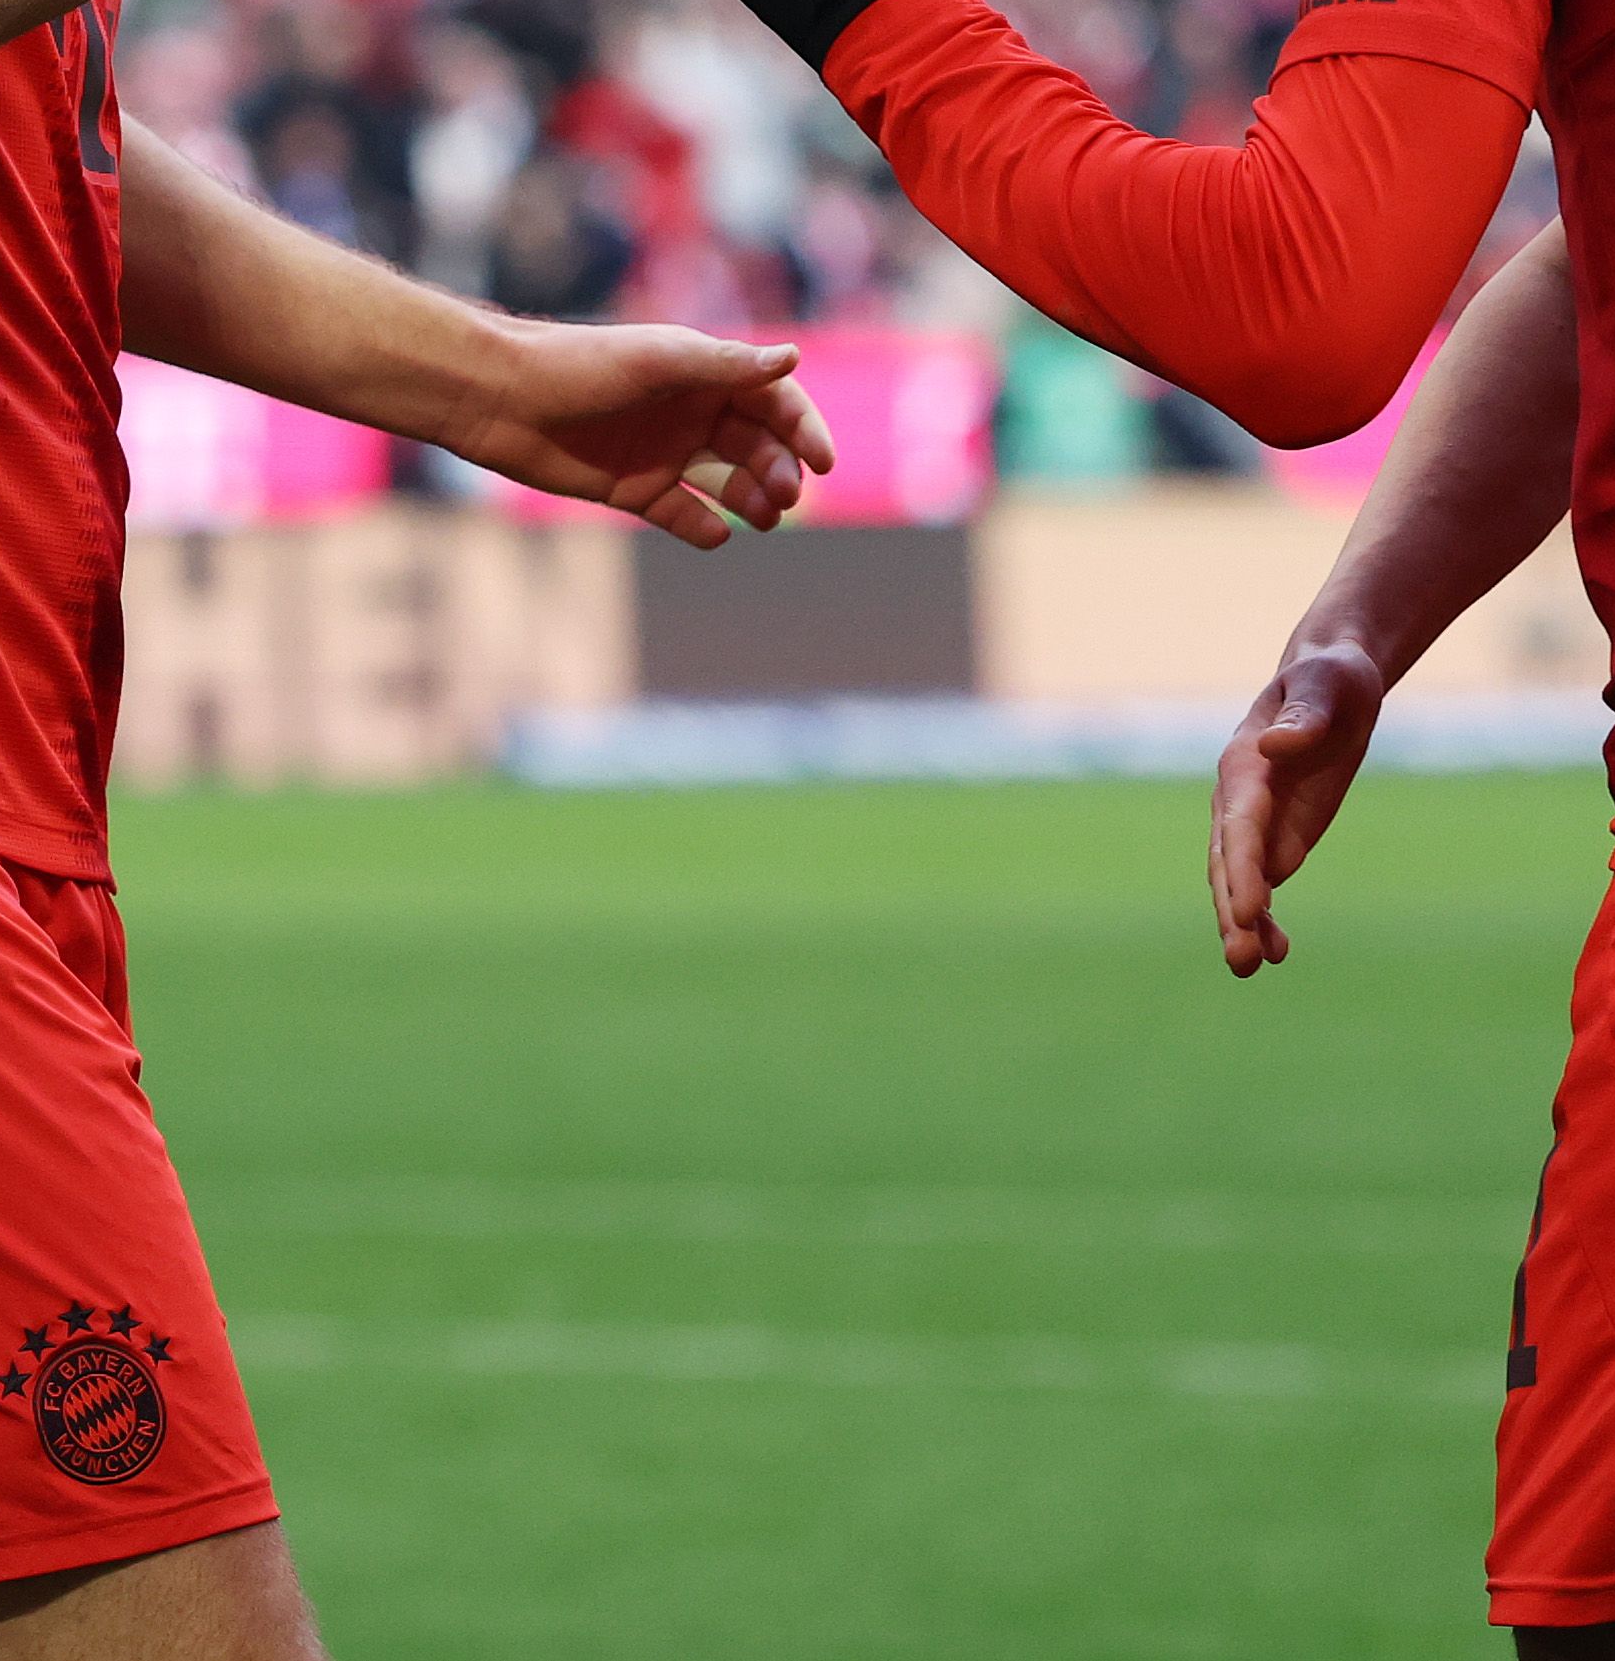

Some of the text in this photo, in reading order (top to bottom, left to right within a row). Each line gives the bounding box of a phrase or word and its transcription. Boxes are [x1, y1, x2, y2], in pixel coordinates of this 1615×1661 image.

[44, 1351, 147, 1412] FC BAYERN
[54, 1419, 157, 1475] MÜNCHEN
